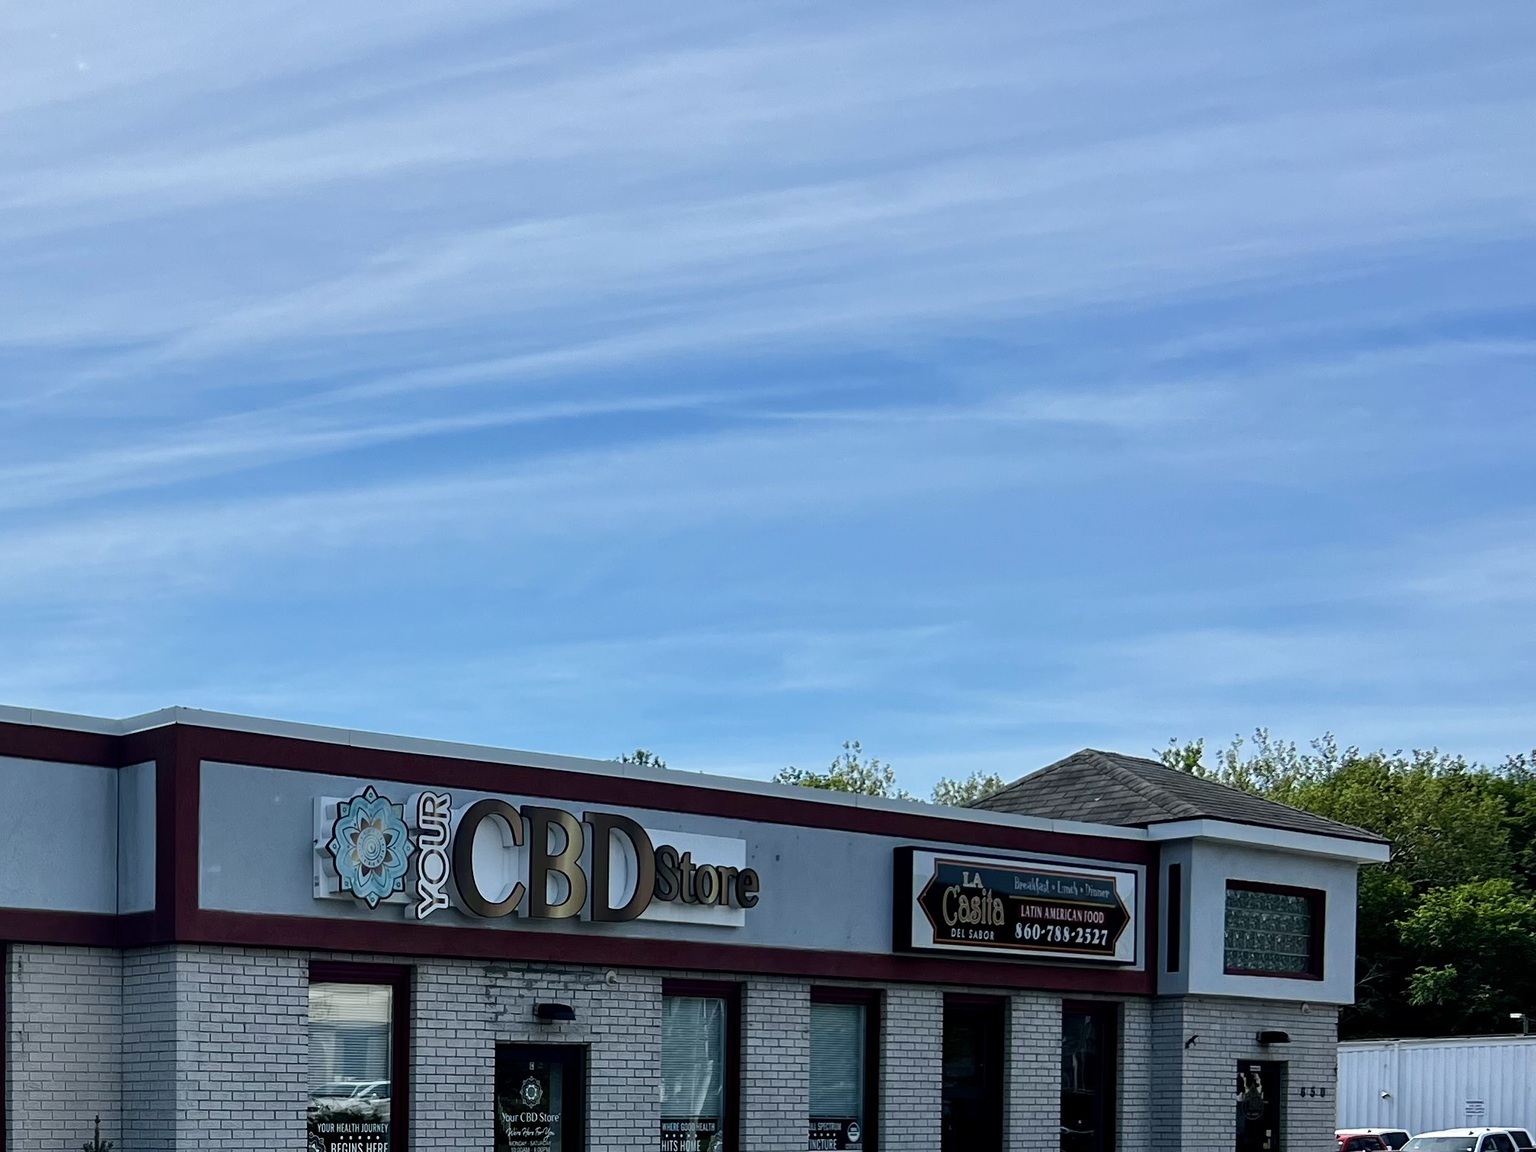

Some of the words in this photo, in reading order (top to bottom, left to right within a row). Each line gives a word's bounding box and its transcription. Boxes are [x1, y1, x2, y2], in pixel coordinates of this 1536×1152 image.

[415, 791, 452, 920] YOUR
[452, 797, 656, 922] CBD
[653, 844, 760, 908] Store
[962, 871, 984, 888] LA
[1014, 876, 1050, 895] Breakfast
[1057, 881, 1078, 896] Lunch
[1085, 883, 1110, 898] Dinner
[942, 885, 1005, 926] Casita
[1020, 905, 1043, 919] LATIN
[1044, 906, 1083, 922] AMERICAN
[1084, 910, 1105, 924] FOOD
[951, 928, 965, 938] DEL
[968, 929, 995, 940] SABOR
[1014, 922, 1109, 946] 860-788-2527
[501, 1112, 519, 1122] Your
[520, 1112, 538, 1122] CBD
[317, 1123, 335, 1133] YOUR
[336, 1123, 360, 1133] HEALTH
[361, 1123, 389, 1133] JOURNEY
[662, 1140, 678, 1151] HITS
[680, 1140, 701, 1151] HOME
[809, 1139, 837, 1150] INCTURE
